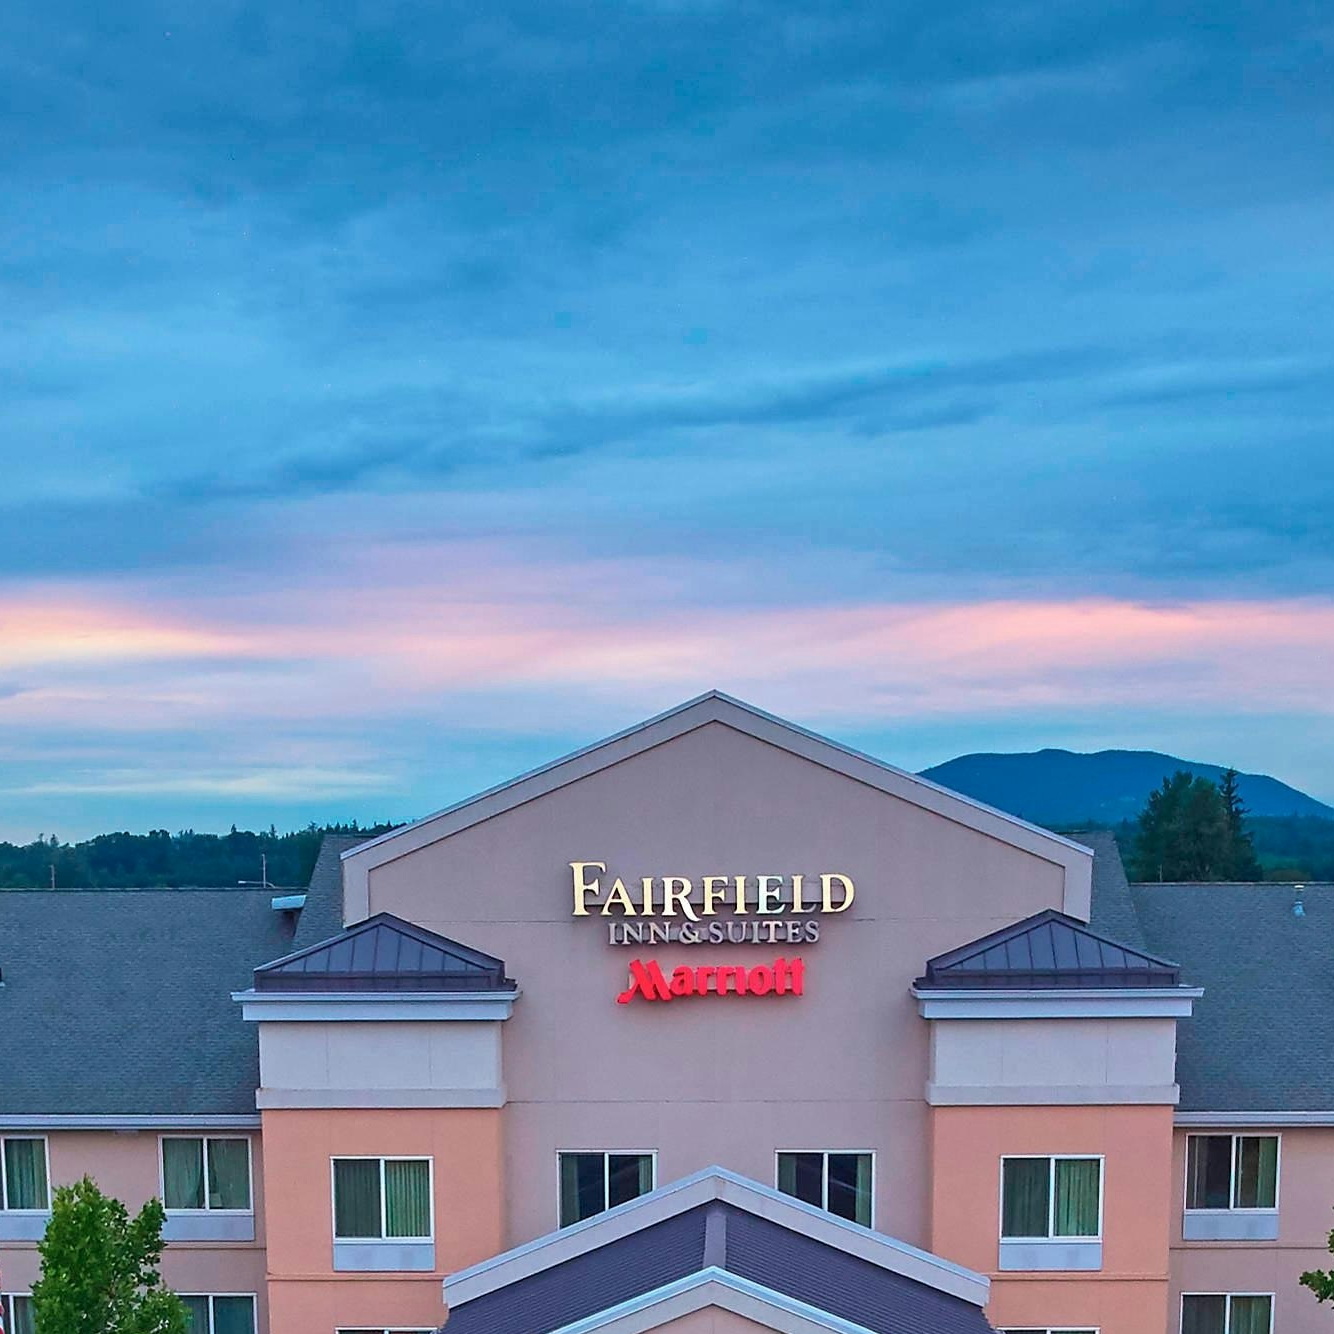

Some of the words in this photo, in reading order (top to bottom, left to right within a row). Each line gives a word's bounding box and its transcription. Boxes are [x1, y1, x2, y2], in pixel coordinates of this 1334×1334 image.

[569, 861, 856, 922] FAIRFIELD
[609, 920, 671, 945] INN
[679, 921, 702, 945] &
[709, 920, 820, 944] SUITES
[616, 956, 805, 1003] Marriott
